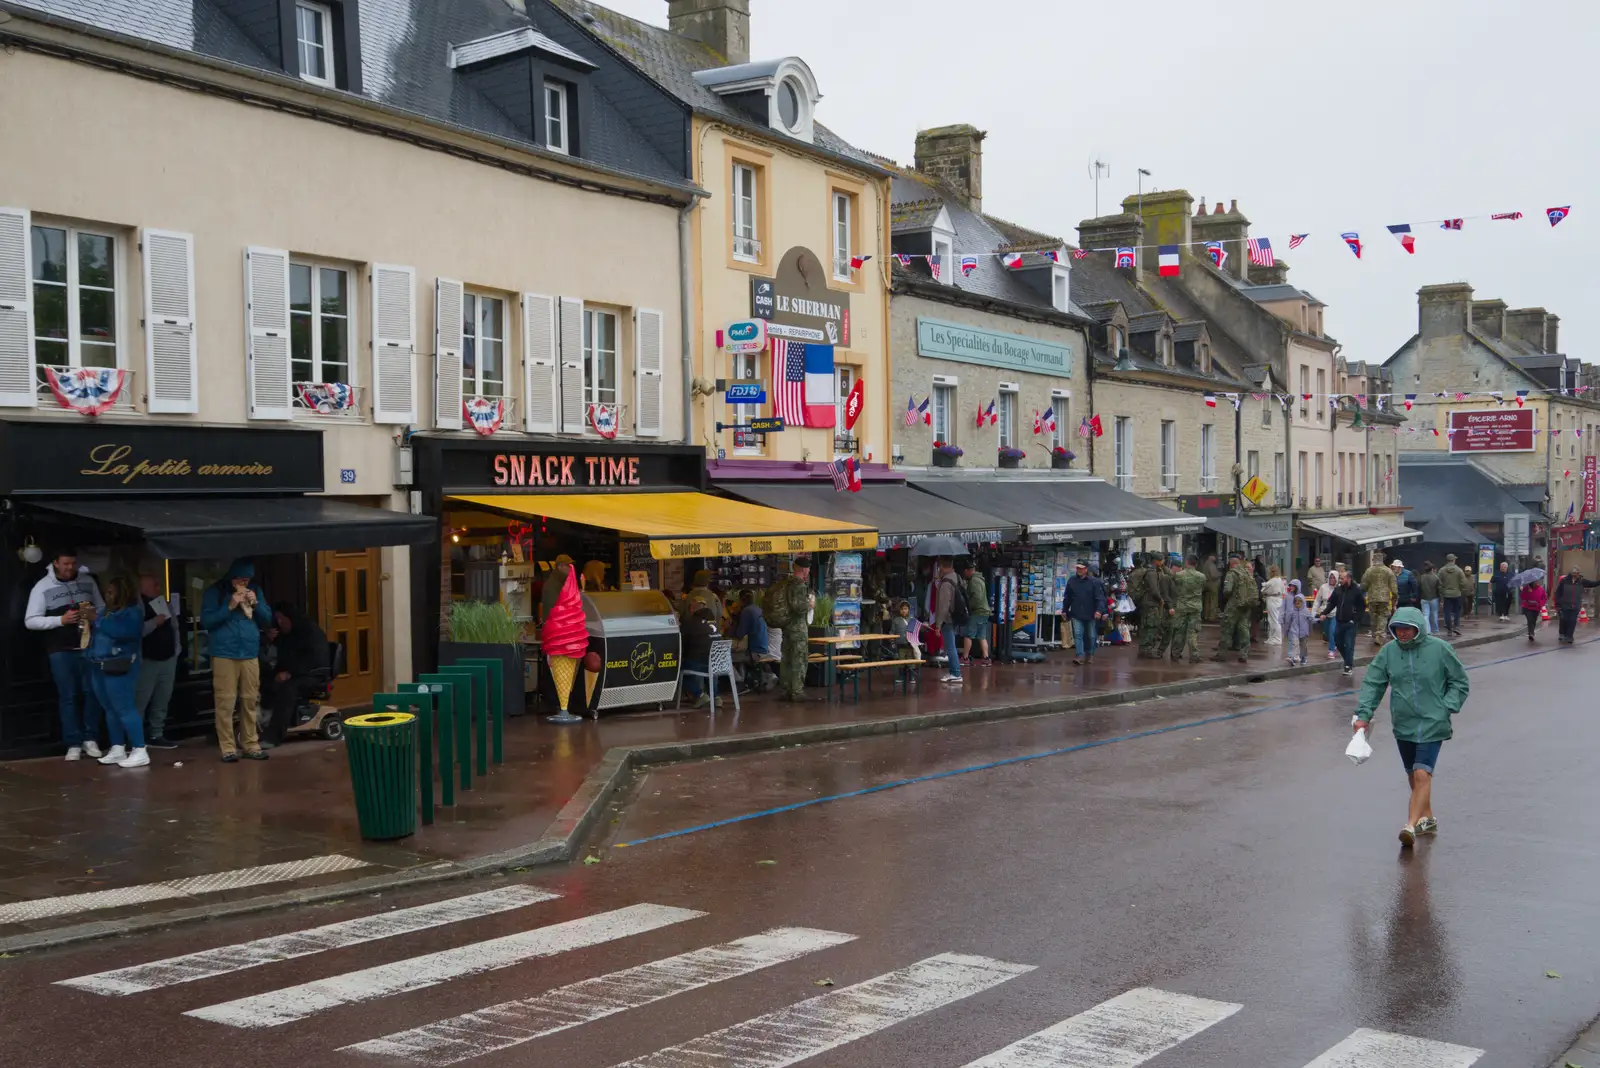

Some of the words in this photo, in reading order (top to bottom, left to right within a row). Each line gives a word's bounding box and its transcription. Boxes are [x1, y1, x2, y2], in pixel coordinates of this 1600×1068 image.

[755, 295, 773, 306] CASH
[776, 295, 789, 312] LE
[791, 297, 841, 320] SHERMAN
[731, 329, 745, 337] PMU
[931, 327, 945, 344] Les
[946, 330, 990, 353] Spécialités
[991, 341, 1003, 355] du
[1003, 342, 1029, 365] Bocage
[1031, 347, 1064, 366] Normand
[731, 386, 748, 396] FDJ
[848, 391, 860, 417] CASH
[80, 443, 132, 476] La
[121, 458, 192, 484] petite
[197, 461, 273, 476] armoire
[494, 454, 576, 486] SNACK
[585, 456, 641, 486] TIME
[342, 471, 354, 482] 39
[1586, 457, 1594, 510] RESTAURANT
[818, 537, 839, 549] Desserts
[877, 536, 898, 549] BAC
[960, 530, 1002, 544] SOUVENIRS
[670, 543, 701, 556] Sandwichs
[750, 540, 773, 552] Boissons
[606, 661, 628, 669] GLACES
